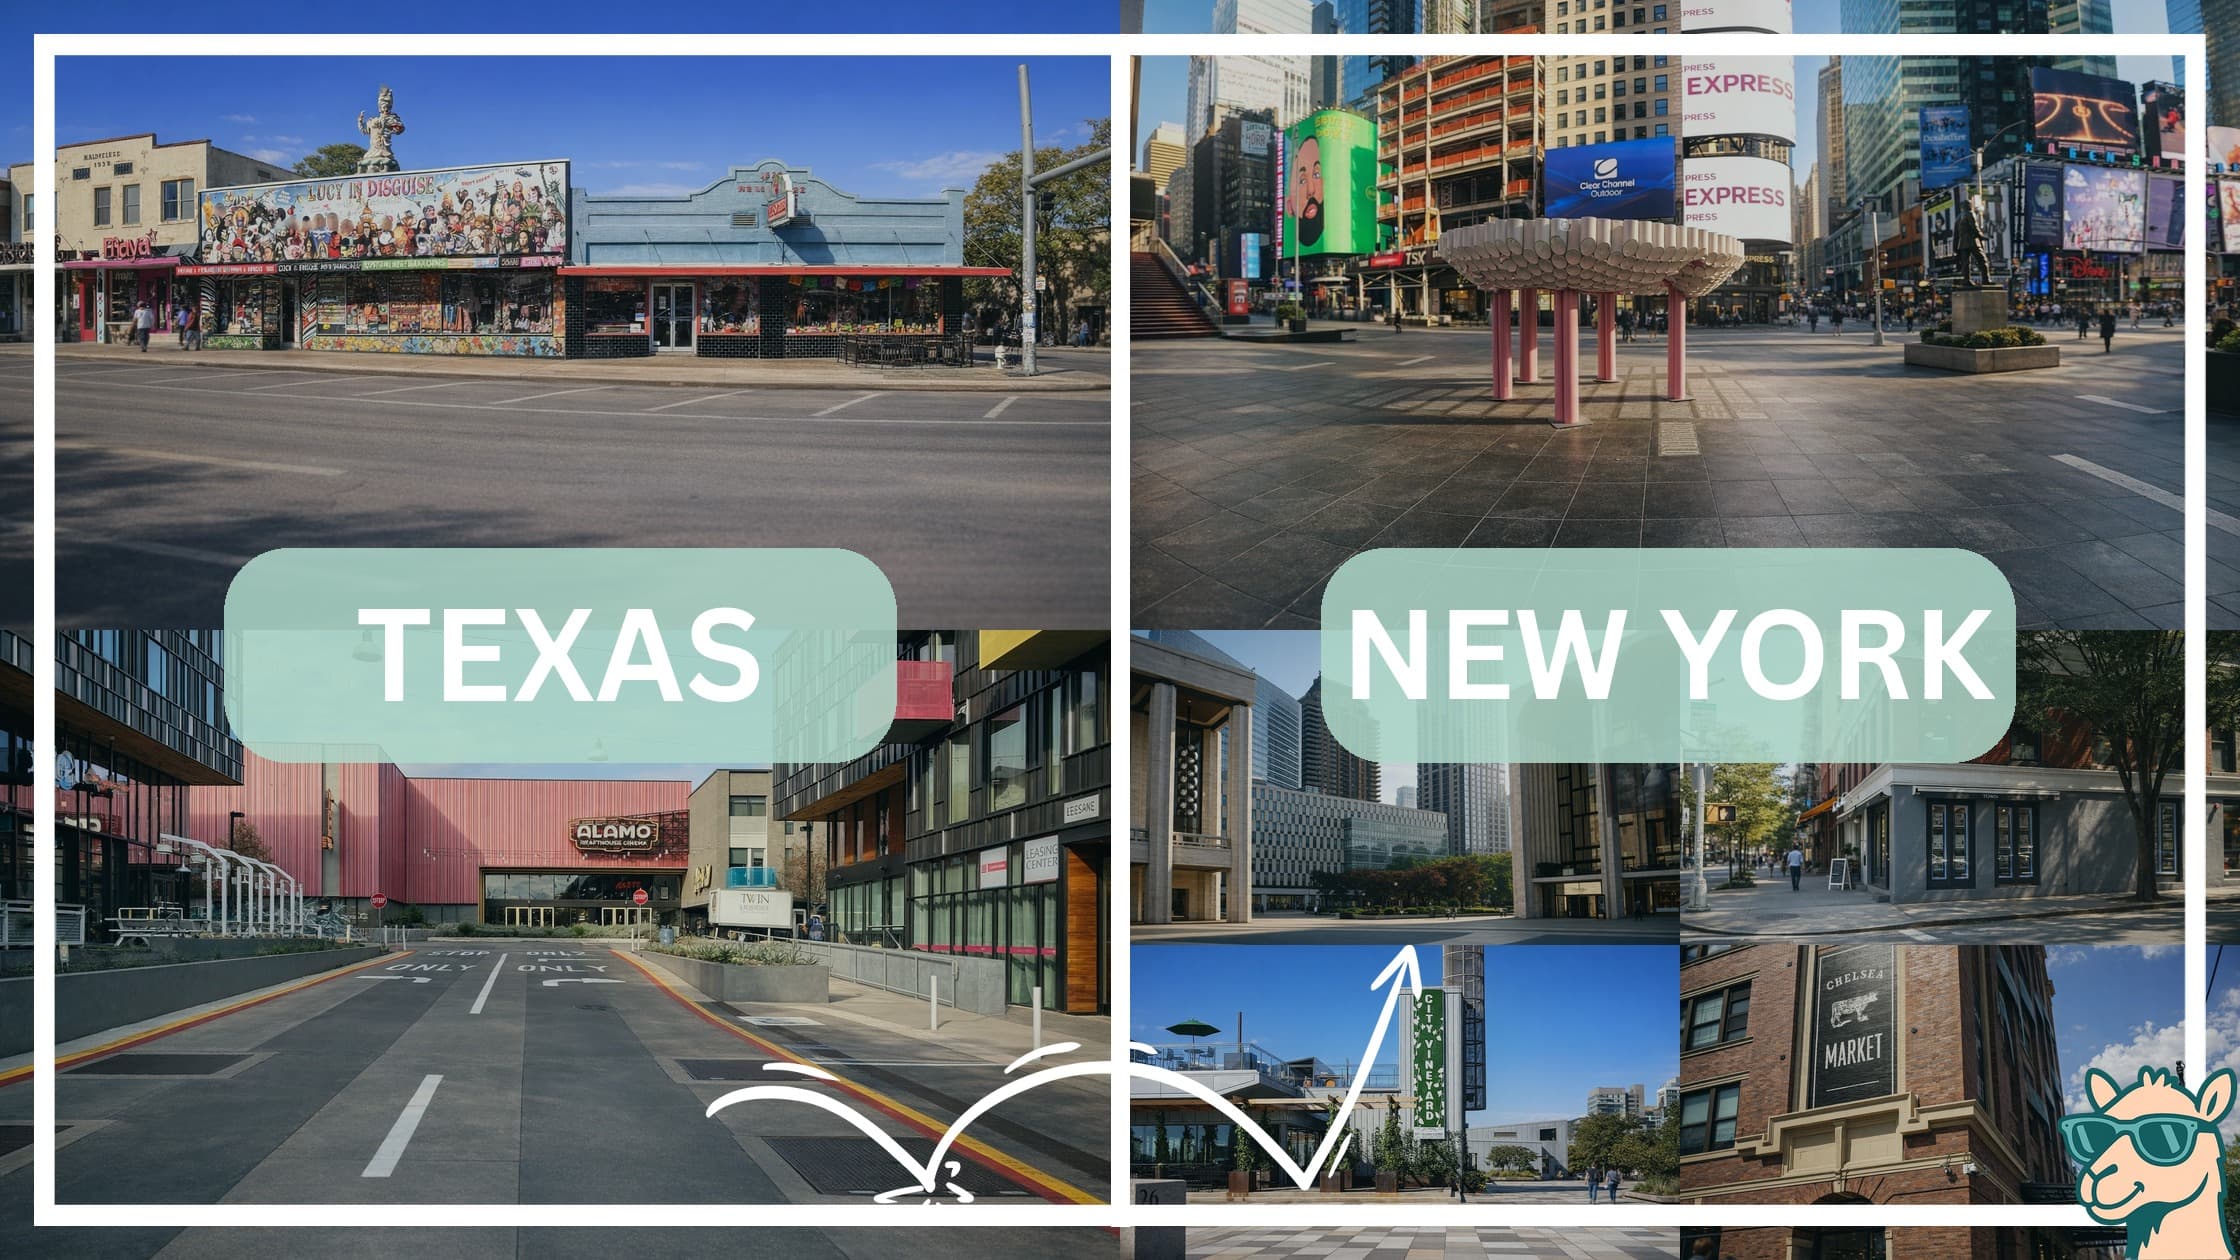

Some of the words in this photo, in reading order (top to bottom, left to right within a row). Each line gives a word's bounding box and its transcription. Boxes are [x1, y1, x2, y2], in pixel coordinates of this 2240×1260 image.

[1687, 74, 1793, 100] EXPRESS
[307, 182, 344, 201] LUCY
[349, 180, 362, 199] IN
[367, 176, 434, 198] DISGUISE
[1579, 181, 1601, 190] Clear
[1601, 179, 1635, 189] Channel
[1590, 189, 1623, 198] Outdoor
[1685, 186, 1785, 207] EXPRESS
[577, 824, 651, 839] ALAMO
[1025, 844, 1058, 860] LEASING
[1025, 857, 1058, 870] CENTER
[742, 893, 770, 904] TWIN
[384, 963, 478, 972] ONLY
[517, 964, 608, 973] ONLY
[1826, 969, 1884, 990] CHELSEA
[1424, 994, 1433, 1033] CITY
[1825, 1033, 1883, 1070] MARKET
[1424, 1039, 1434, 1120] VINEYARD
